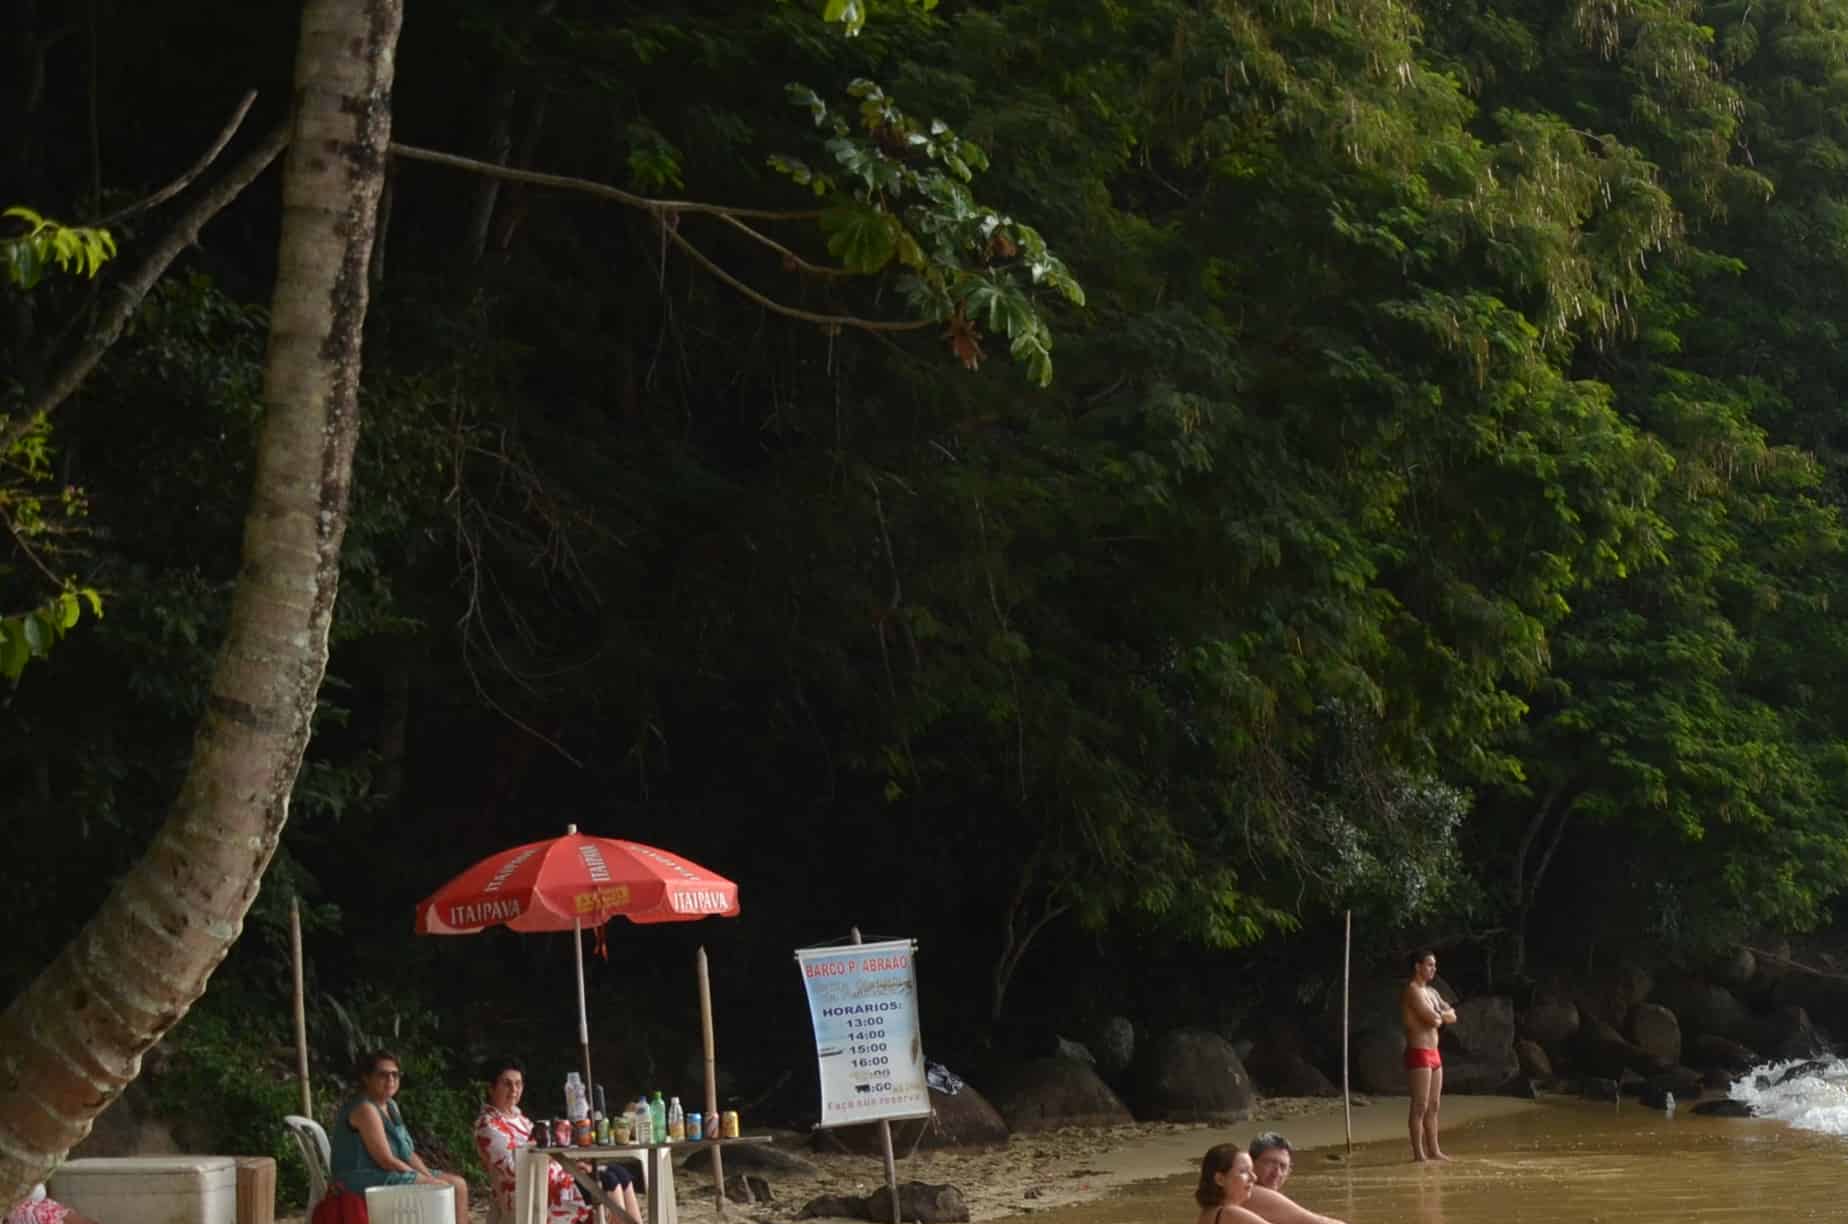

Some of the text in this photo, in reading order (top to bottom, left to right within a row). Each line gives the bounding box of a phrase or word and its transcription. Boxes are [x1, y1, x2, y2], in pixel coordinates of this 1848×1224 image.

[673, 891, 728, 912] ITAIPAVA
[449, 898, 520, 925] ITAIPAVA
[805, 959, 846, 979] BARCO
[847, 1016, 884, 1028] 13:00
[848, 1030, 886, 1041] 14:00
[849, 1042, 888, 1054] 15:00
[852, 1055, 889, 1068] 16:00
